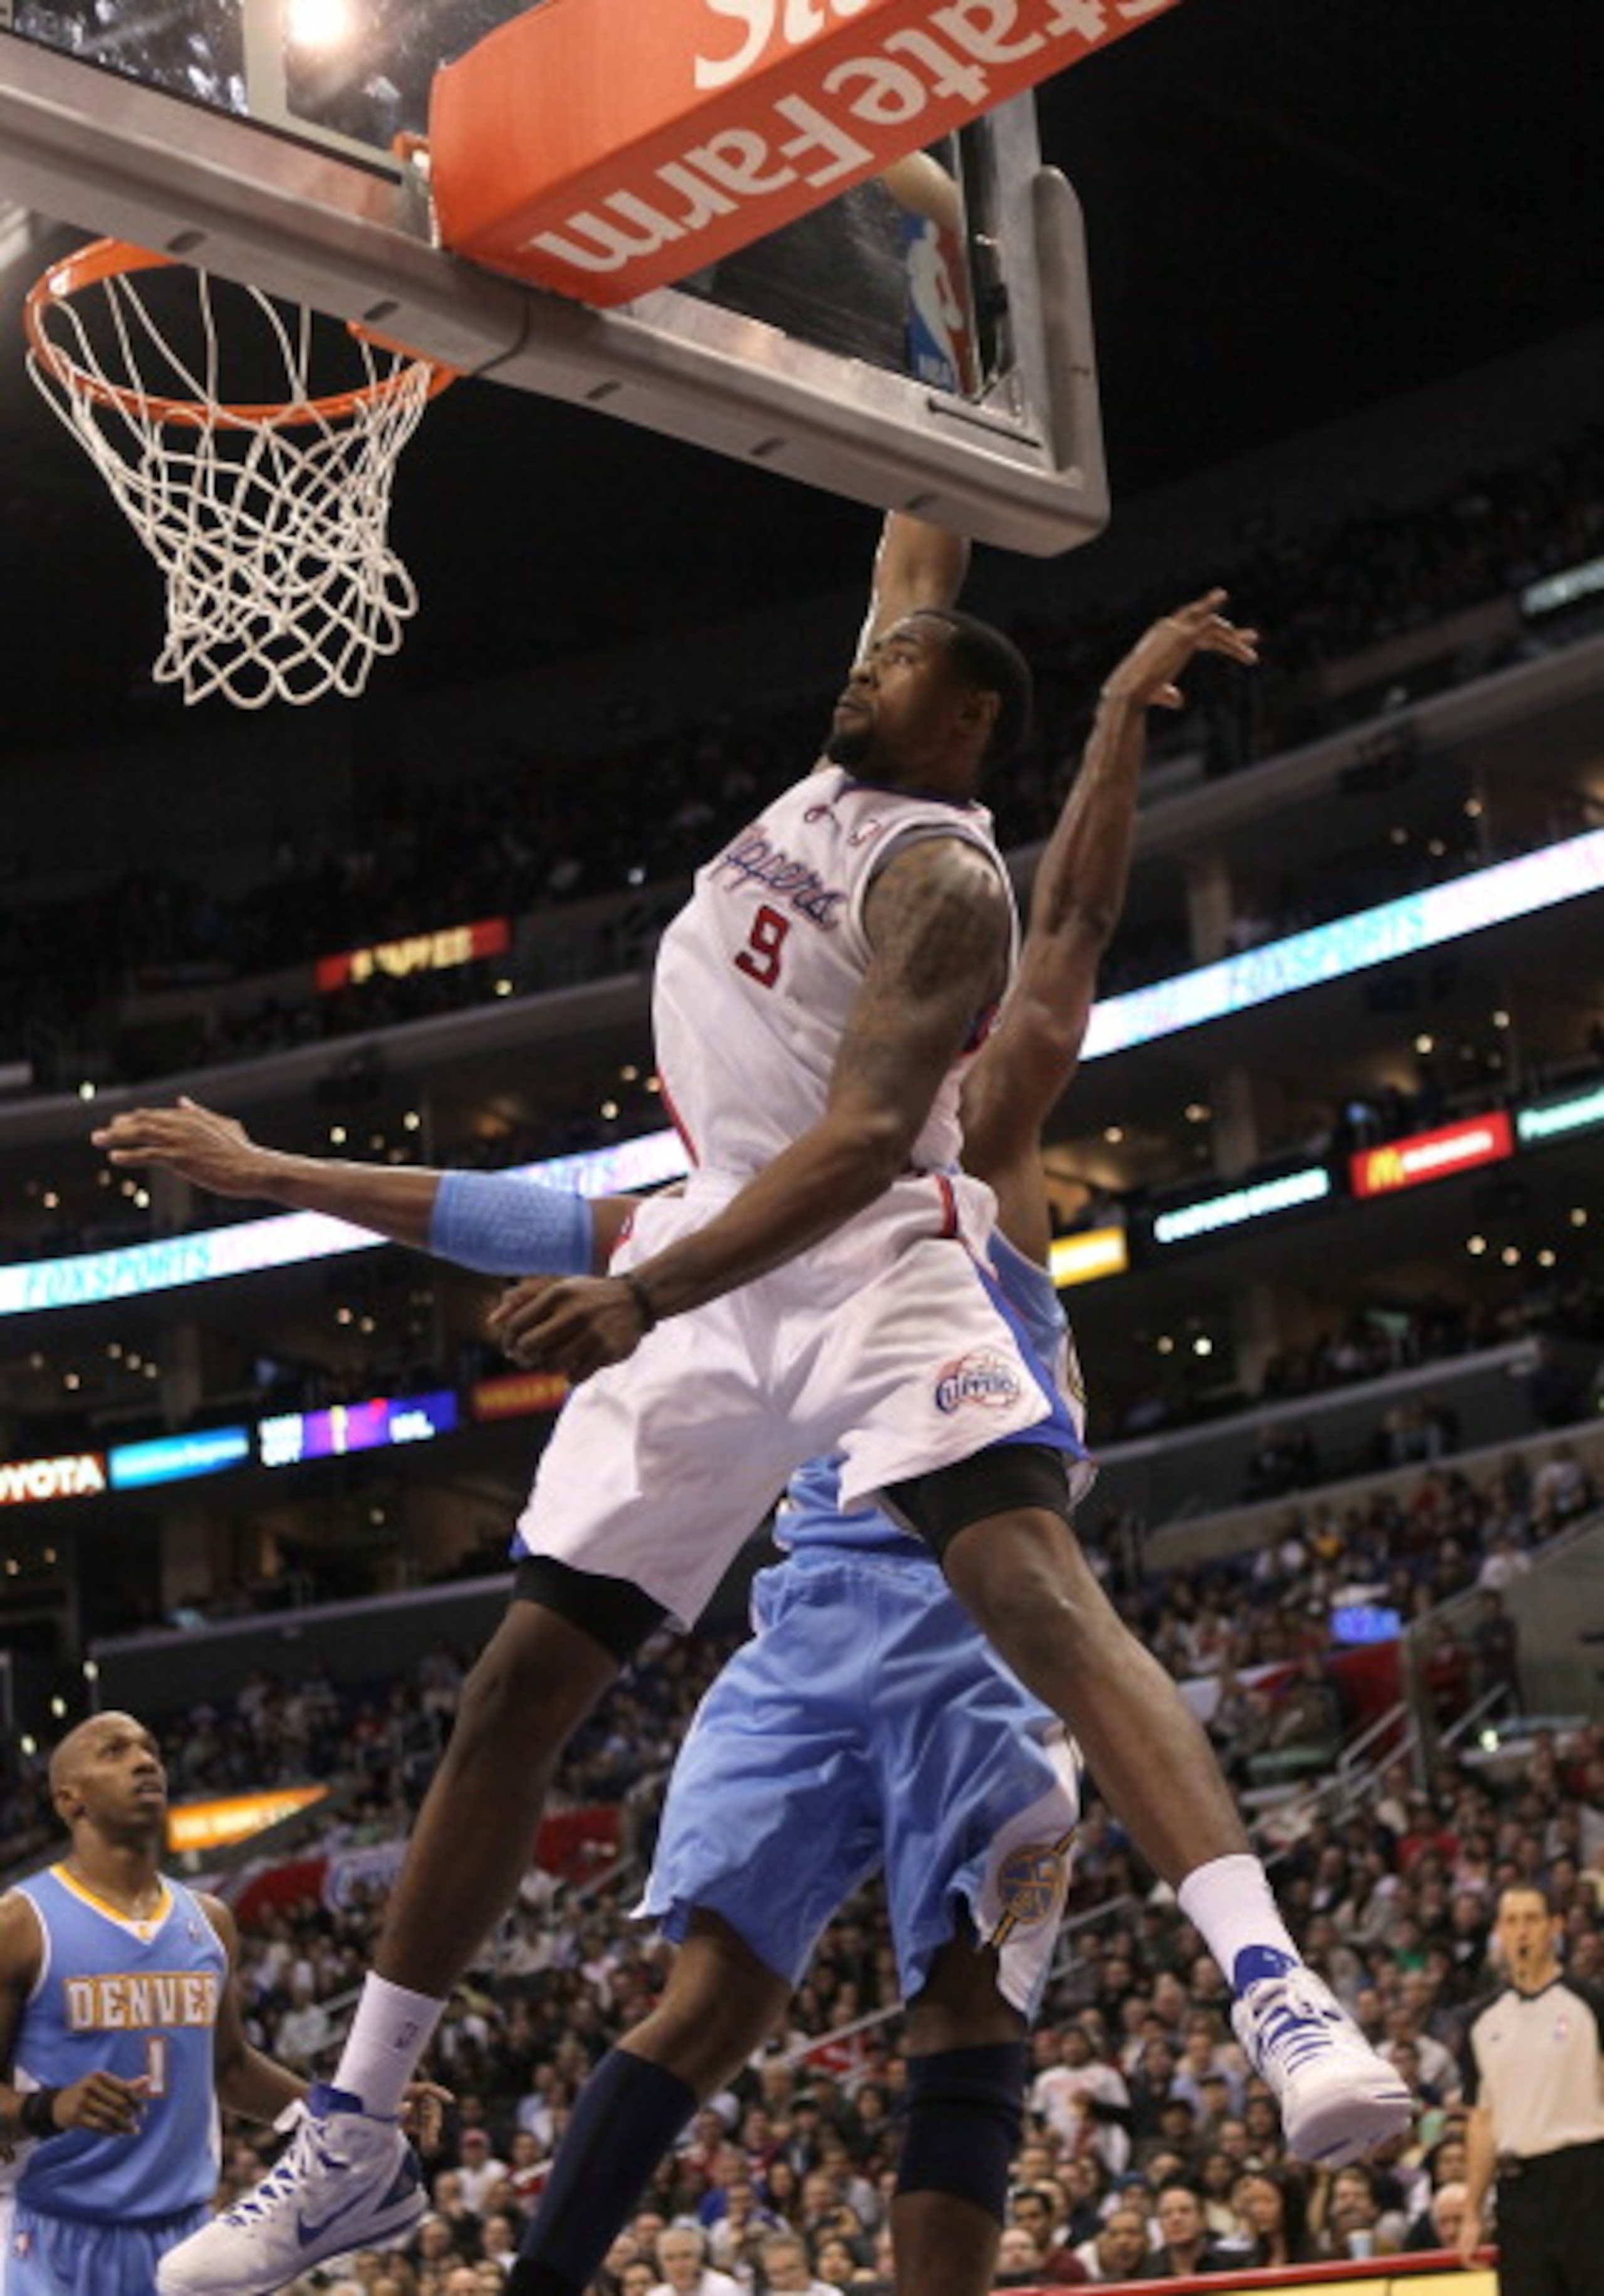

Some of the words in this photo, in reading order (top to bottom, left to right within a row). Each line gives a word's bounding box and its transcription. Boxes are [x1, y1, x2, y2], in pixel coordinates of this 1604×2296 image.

[823, 0, 1167, 124] tate
[529, 94, 874, 271] Farm
[734, 905, 792, 989] 9
[0, 1454, 104, 1500] YOTA
[147, 2037, 167, 2097] 1
